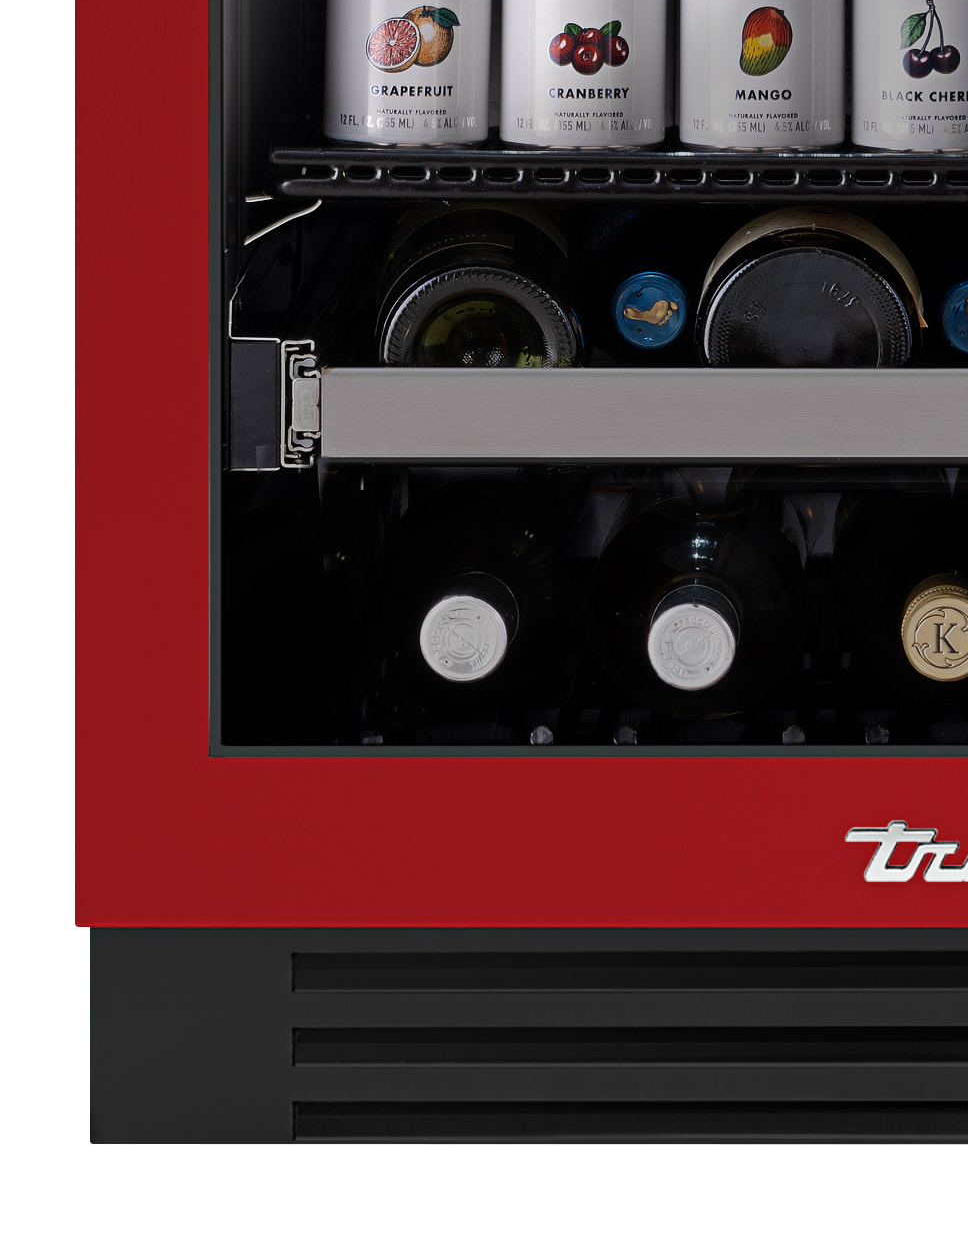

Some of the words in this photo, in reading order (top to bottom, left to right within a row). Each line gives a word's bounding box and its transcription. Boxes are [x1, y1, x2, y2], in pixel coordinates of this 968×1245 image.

[371, 85, 453, 97] GRAPEFRUIT
[549, 88, 629, 99] CRANBERRY
[735, 89, 792, 101] MANGO
[882, 91, 923, 102] BLACK
[339, 114, 347, 125] 12
[516, 118, 523, 128] 12
[576, 121, 592, 132] ML)
[693, 120, 700, 130] 12
[750, 122, 766, 133] ML)
[863, 121, 869, 131] 12
[933, 622, 960, 655] K
